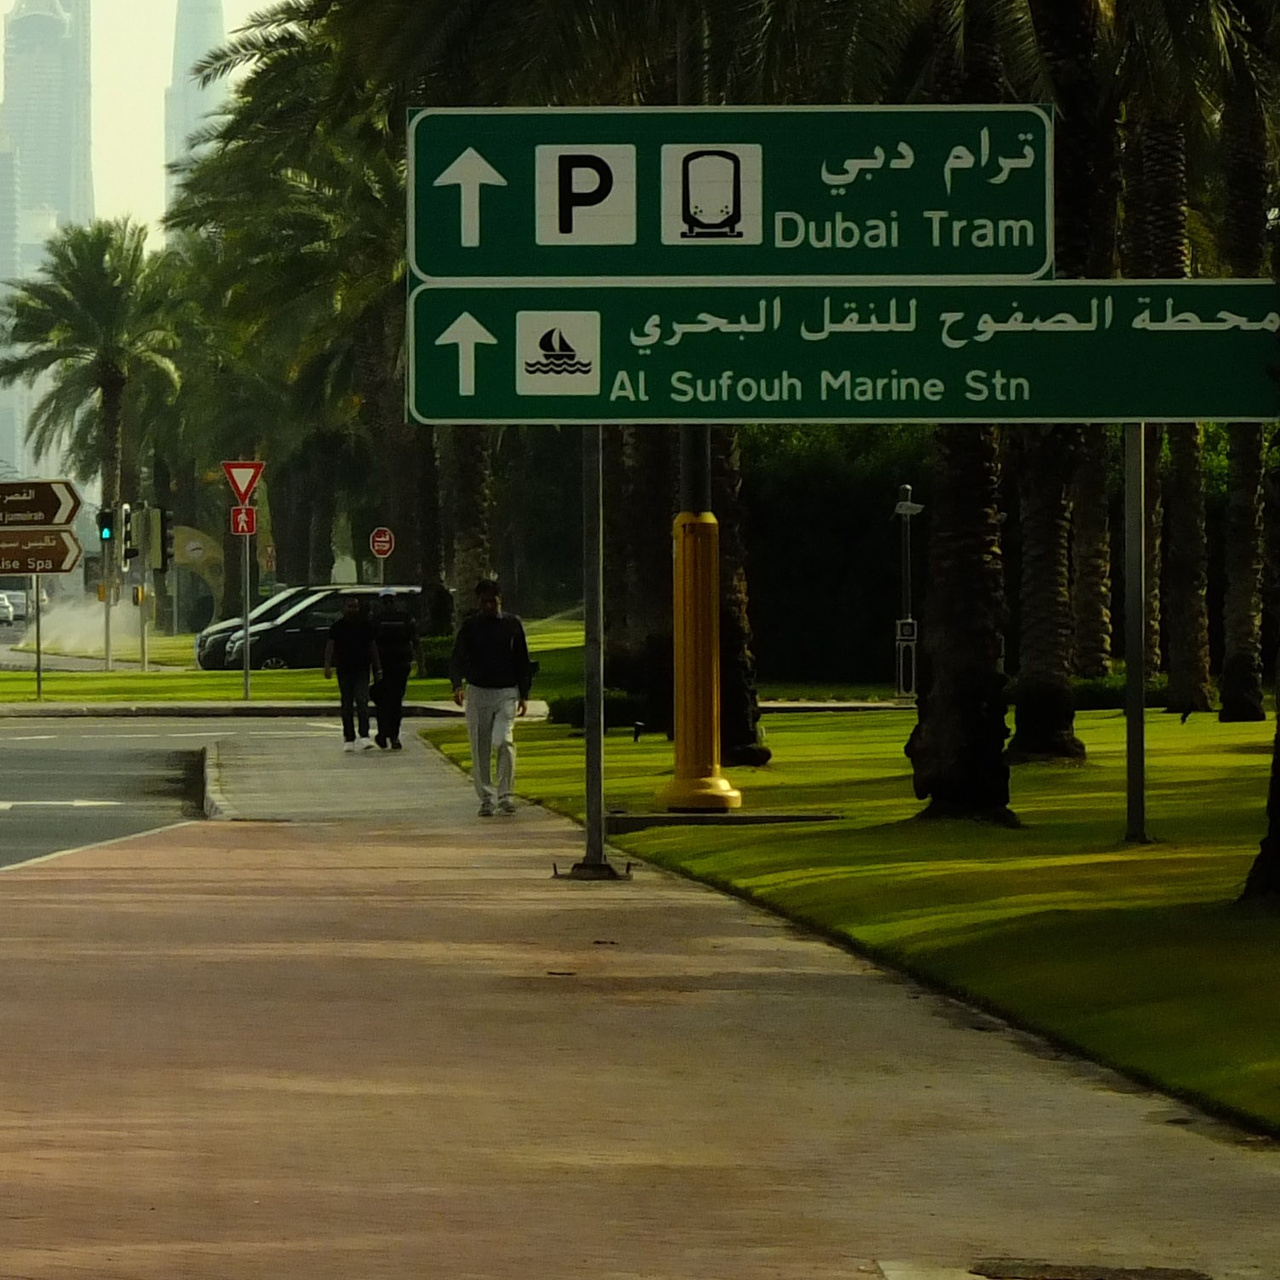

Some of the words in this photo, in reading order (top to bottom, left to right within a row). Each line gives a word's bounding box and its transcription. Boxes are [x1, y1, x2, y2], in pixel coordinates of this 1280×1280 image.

[821, 141, 916, 196] دبي
[943, 126, 1035, 195] ترام
[557, 154, 614, 235] P
[774, 210, 899, 249] Dubai
[923, 210, 1034, 248] Tram
[629, 296, 781, 355] البحري
[800, 296, 917, 341] للنقل
[939, 295, 1113, 349] الصفوح
[1131, 297, 1280, 333] محطة
[609, 370, 649, 402] Al
[670, 370, 802, 403] Sufouh
[820, 368, 945, 402] Marine
[965, 369, 1030, 402] Stn
[27, 557, 53, 572] Spa
